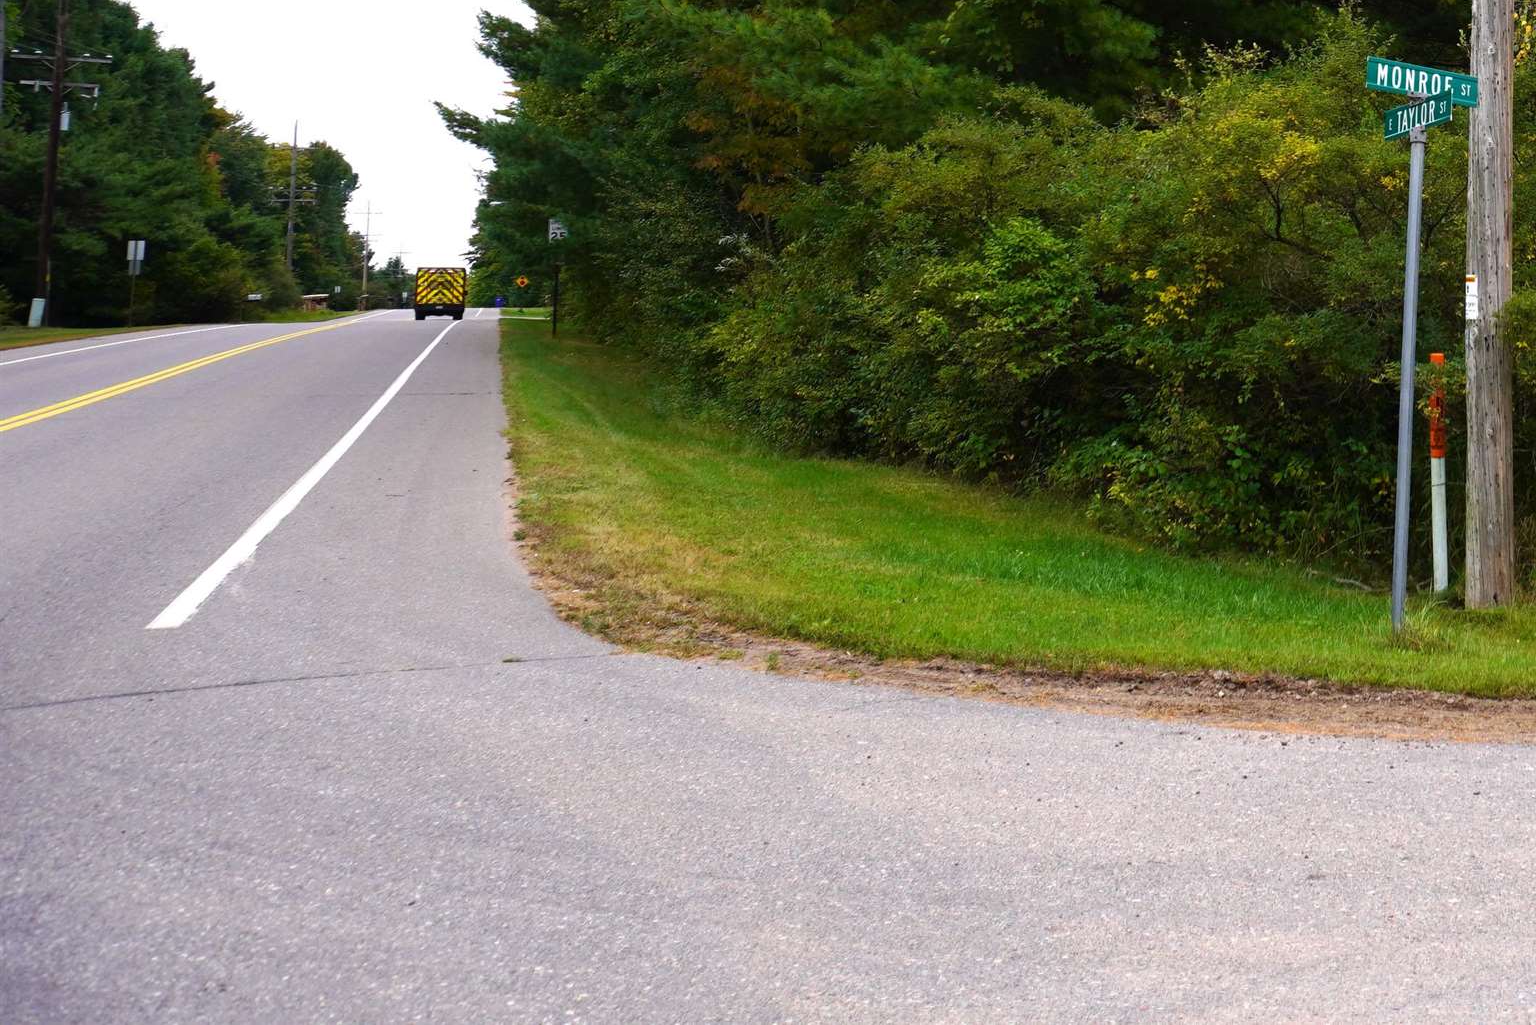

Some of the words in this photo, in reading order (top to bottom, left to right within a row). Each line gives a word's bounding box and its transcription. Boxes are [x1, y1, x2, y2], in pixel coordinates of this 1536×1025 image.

[1461, 83, 1471, 96] ST
[1388, 118, 1393, 131] E
[1397, 100, 1435, 134] TAYLOR
[1440, 100, 1447, 114] ST
